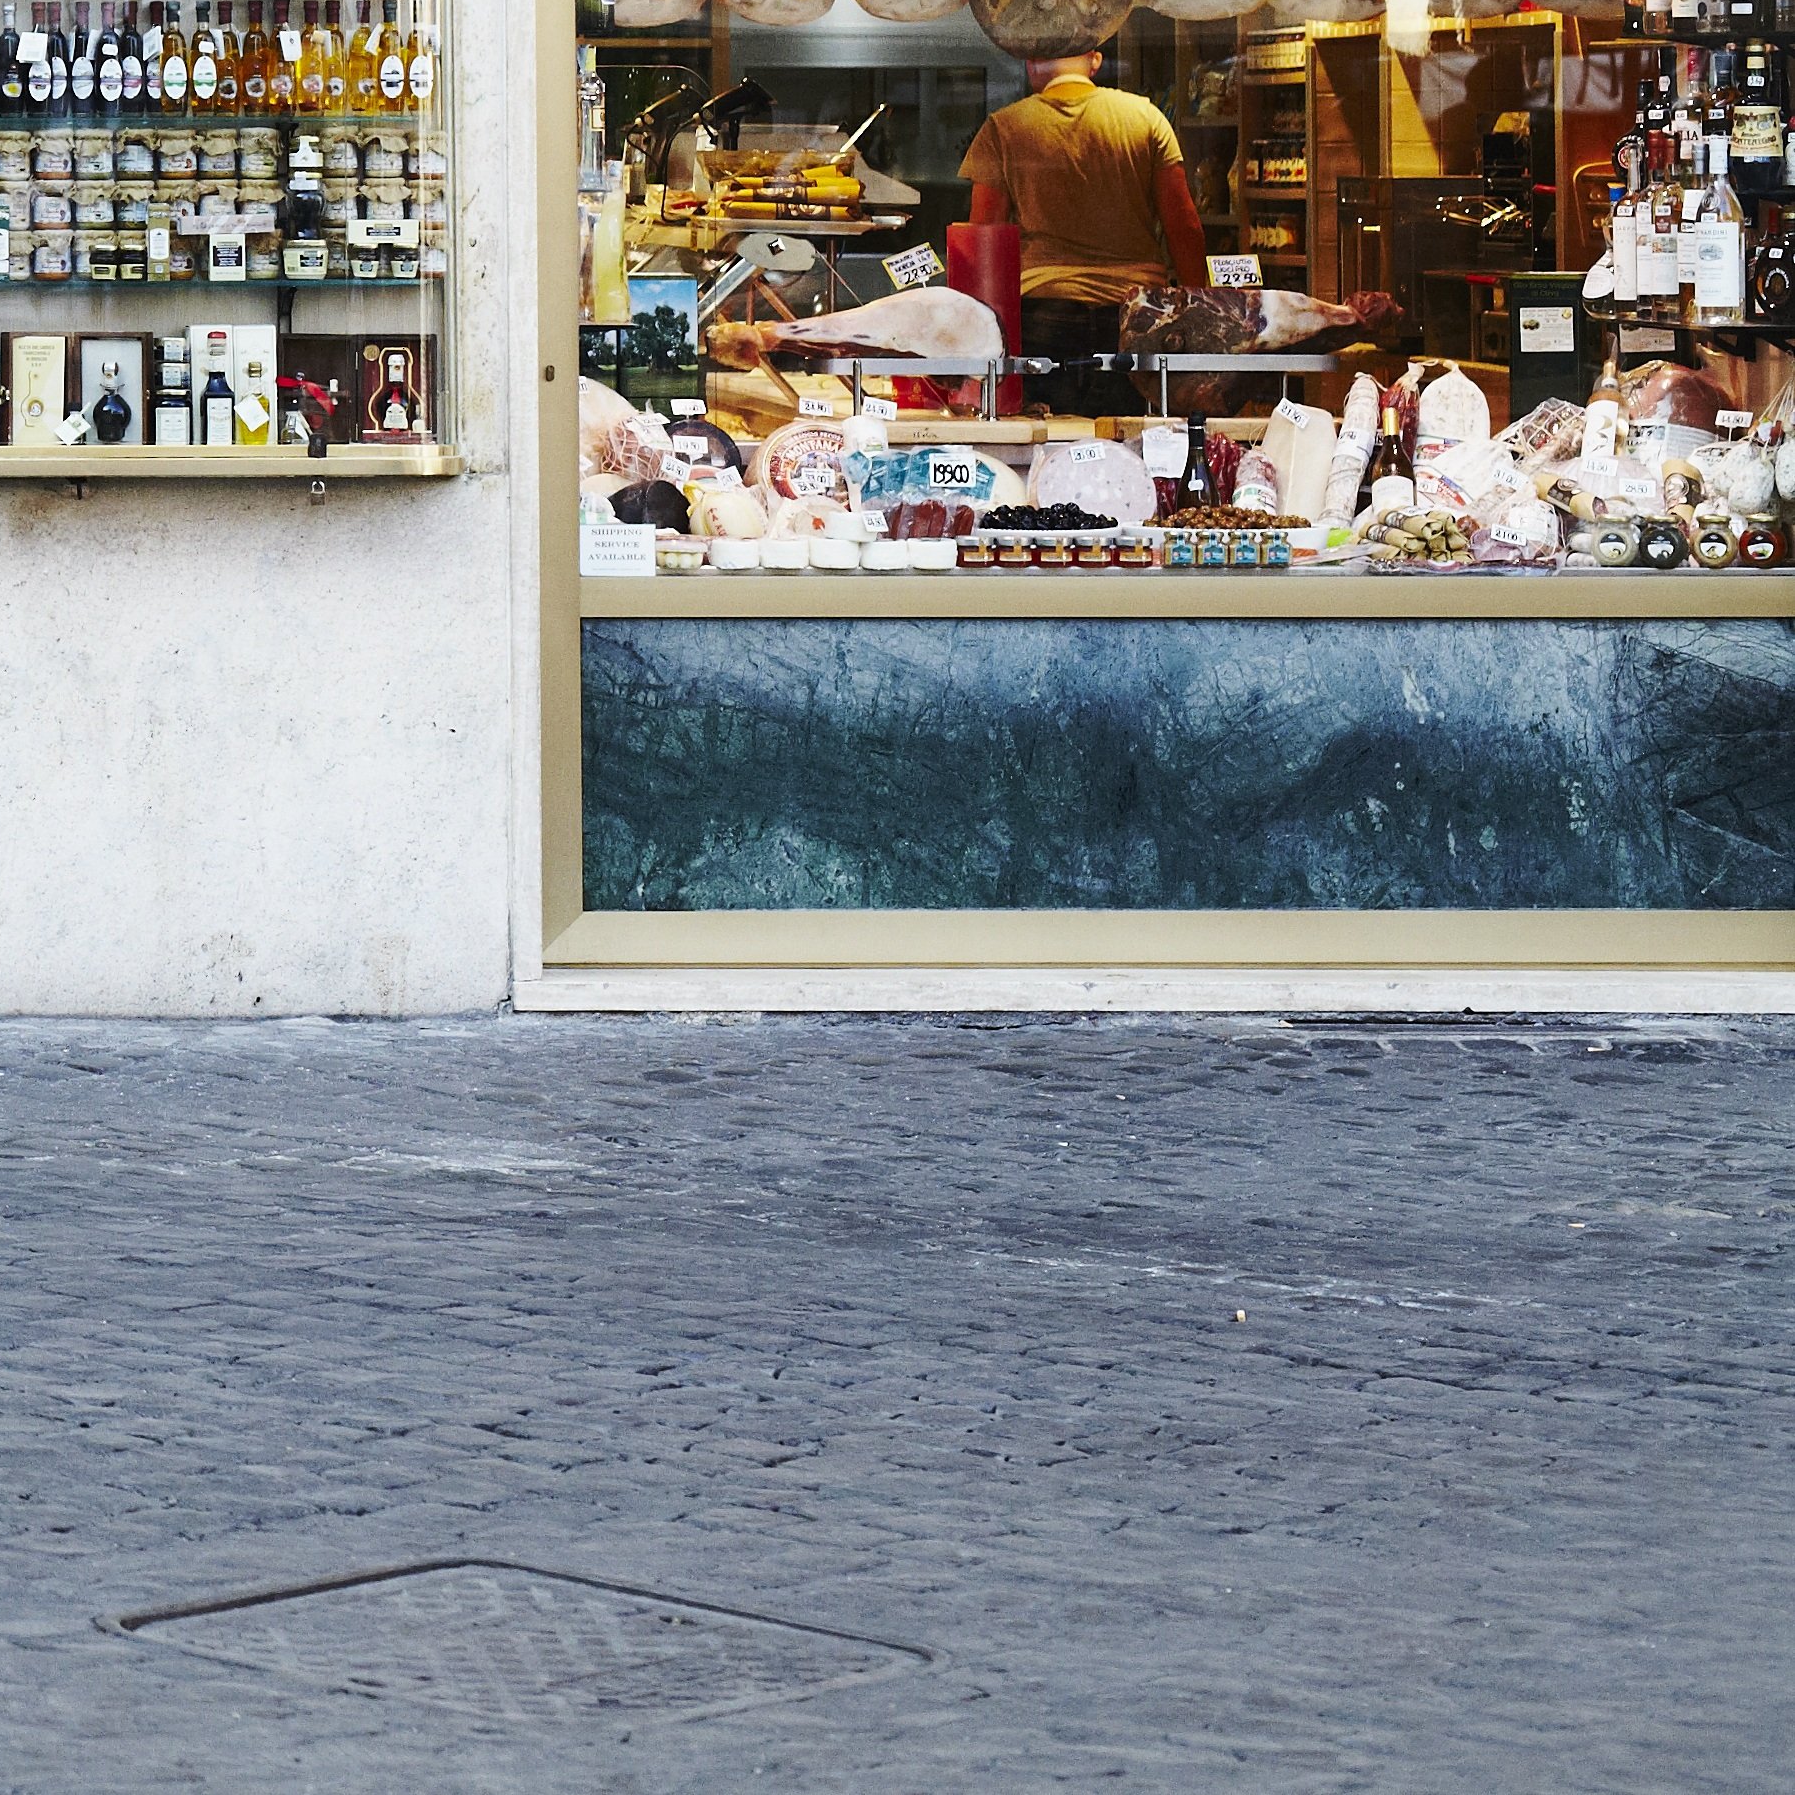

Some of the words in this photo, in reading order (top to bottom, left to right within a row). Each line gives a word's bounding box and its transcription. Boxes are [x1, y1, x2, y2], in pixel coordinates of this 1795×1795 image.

[591, 528, 643, 536] SHIPPING
[594, 540, 640, 548] SERVICE
[588, 553, 647, 561] AVAILABLE
